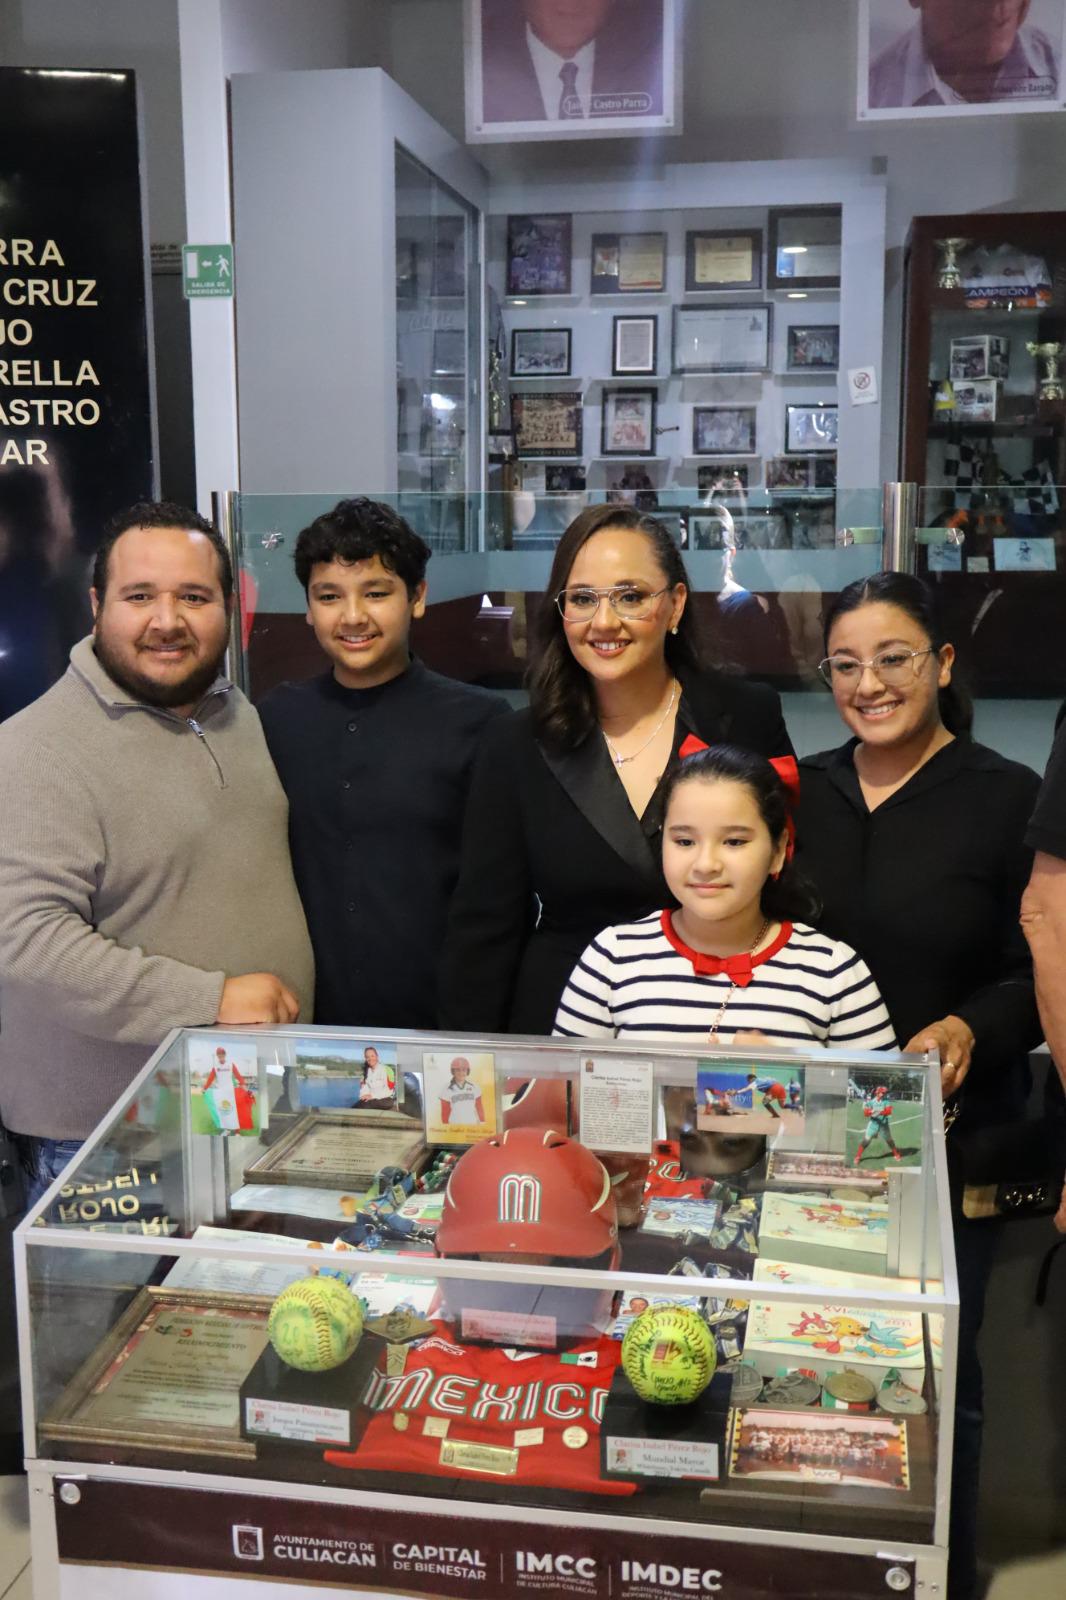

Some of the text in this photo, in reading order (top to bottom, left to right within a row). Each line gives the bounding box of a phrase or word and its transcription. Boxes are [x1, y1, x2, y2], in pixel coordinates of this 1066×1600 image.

[3, 278, 98, 306] CRUZ
[0, 439, 50, 465] AR
[643, 1454, 676, 1463] Mundial
[273, 1534, 374, 1551] AYUNTAMIENTO DE
[273, 1545, 376, 1567] CULIACÁN
[392, 1543, 487, 1567] CAPITAL
[516, 1550, 597, 1579] IMCC
[393, 1561, 487, 1580] DE BIENESTAR
[518, 1573, 594, 1587] INSTITUTO MUNICIPAL
[621, 1560, 723, 1591] IMDEC
[527, 1581, 560, 1589] CULTURA
